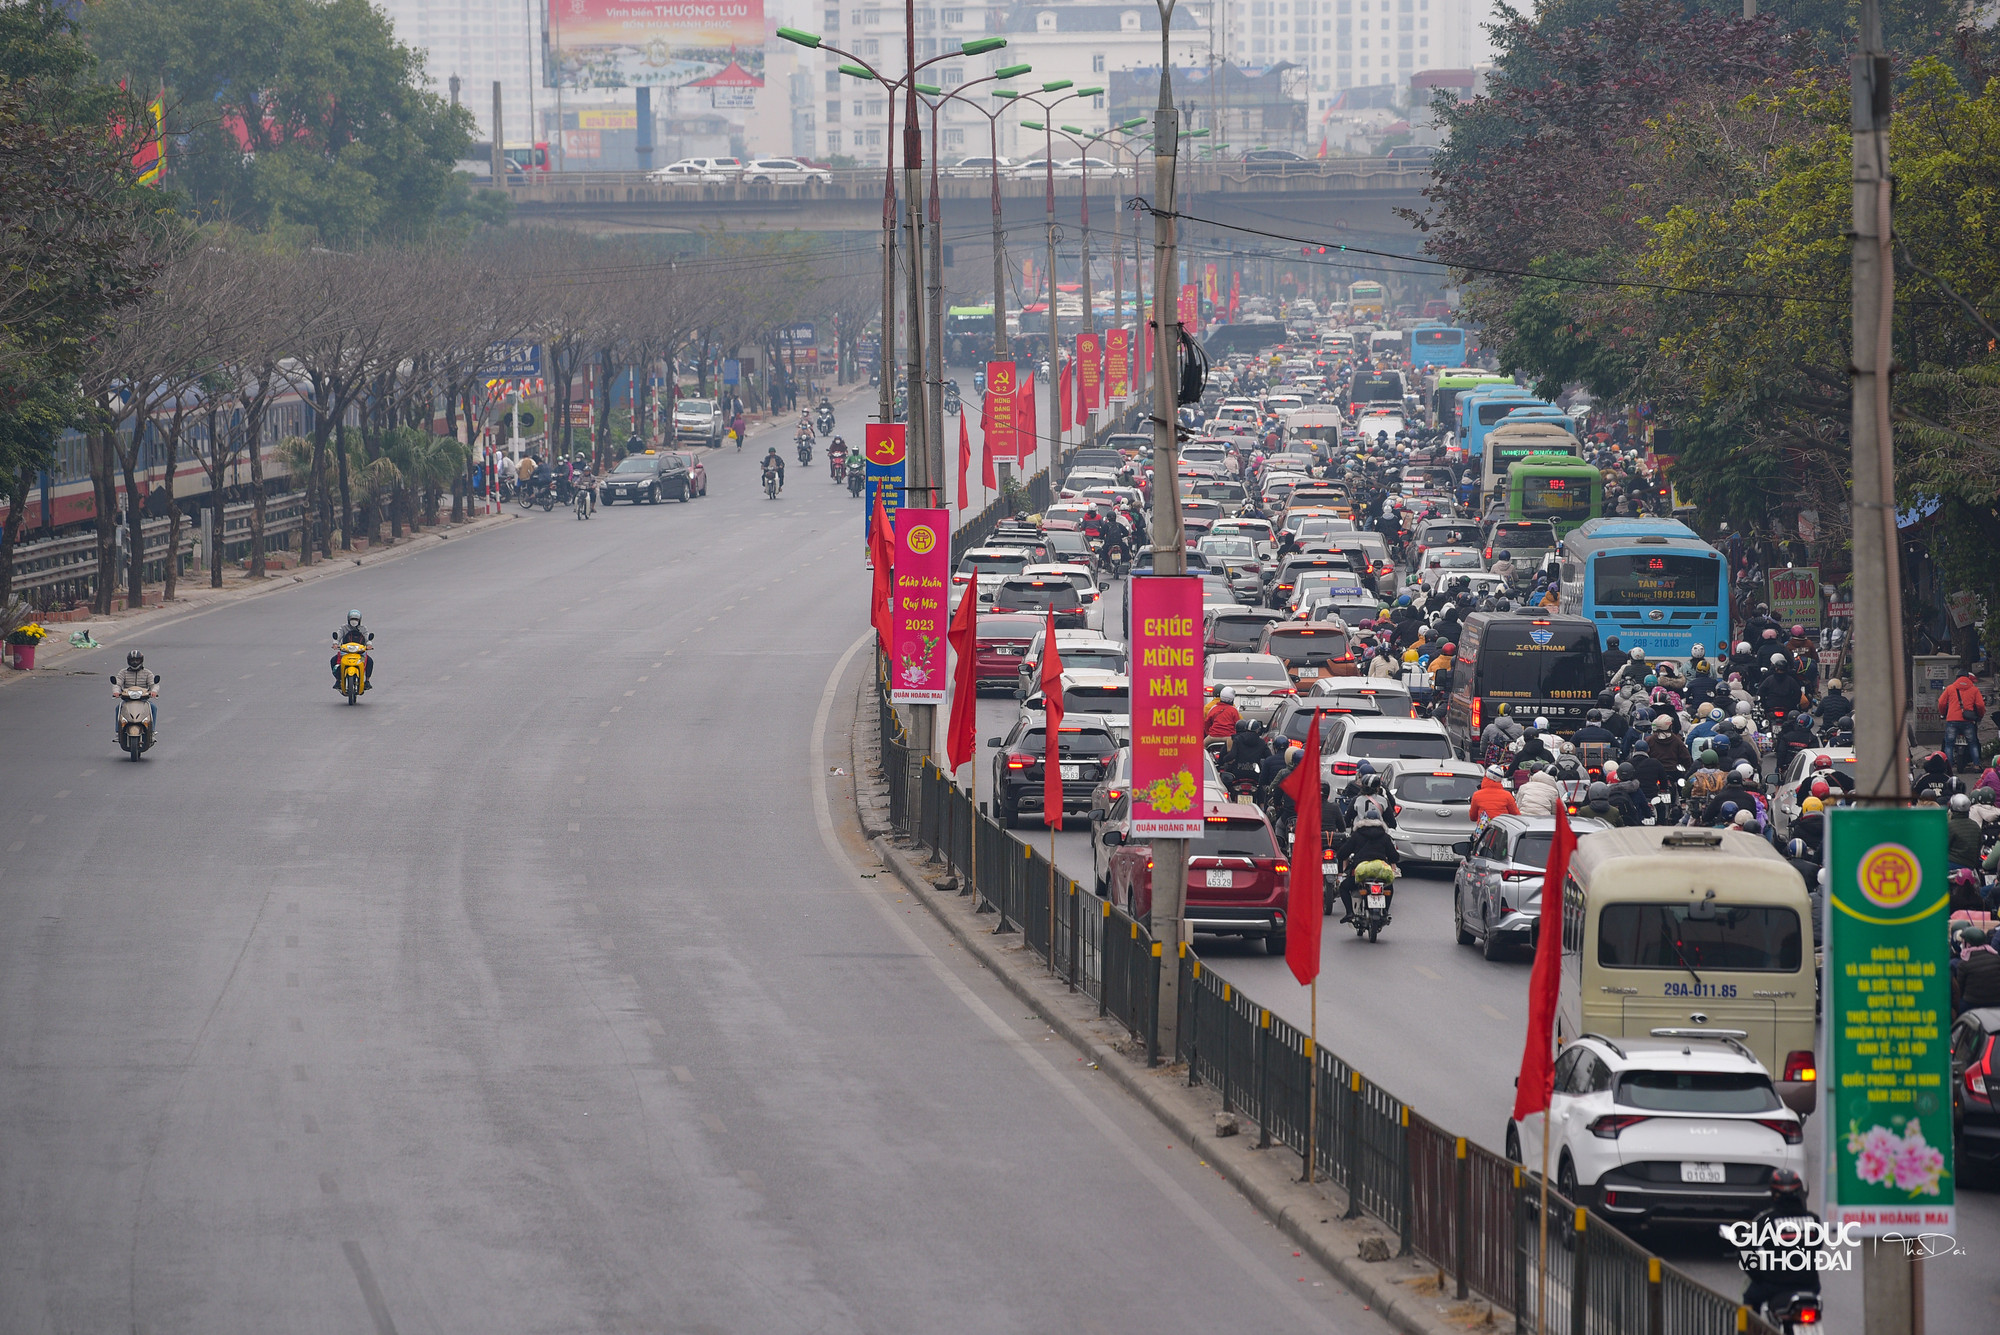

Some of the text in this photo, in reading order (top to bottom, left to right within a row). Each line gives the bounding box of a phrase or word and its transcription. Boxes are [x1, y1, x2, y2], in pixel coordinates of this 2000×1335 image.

[655, 4, 715, 19] THƯỢNG
[720, 4, 747, 16] LƯU
[1549, 480, 1566, 490] 104
[1649, 558, 1664, 569] 6A
[898, 575, 942, 588] Chào Xuân
[1773, 572, 1797, 600] PHỞ
[1653, 590, 1696, 599] 1900.1296
[902, 597, 938, 611] Quý Mão
[905, 619, 934, 631] 2023
[1144, 614, 1193, 637] CHÚC
[1633, 639, 1648, 648] 29B
[1654, 639, 1680, 648] 210.03
[1142, 644, 1194, 666] MỪNG
[1150, 674, 1188, 696] NĂM
[894, 690, 908, 700] QUẬN
[910, 690, 930, 699] HOÀNG
[1550, 690, 1592, 699] 19001731
[1152, 704, 1185, 727] MỚI
[1141, 734, 1197, 746] XUÂN QUÝ MÃO
[1159, 748, 1178, 756] 2023
[1136, 822, 1201, 833] QUẬN HOÀNG MAI
[1212, 870, 1226, 878] 30F
[1208, 878, 1232, 886] 453.29
[1871, 944, 1910, 962] ĐẢNG BỘ
[1846, 960, 1936, 976] VÀ NHÂN DÂN THỦ ĐÔ
[1664, 982, 1738, 998] 29A-011.85
[1753, 990, 1796, 998] COUNTY
[1858, 978, 1924, 993] RA SỨC THI ĐUA
[1867, 992, 1916, 1008] QUYẾT TÂM
[1846, 1008, 1936, 1025] THỰC HIỆN THẮNG LỢI
[1845, 1025, 1874, 1041] NHIỆM
[1876, 1027, 1888, 1041] VỤ
[1888, 1024, 1911, 1040] PHÁT
[1856, 1040, 1879, 1054] KINH
[1880, 1040, 1890, 1055] TẾ
[1898, 1041, 1910, 1055] XÃ
[1911, 1040, 1927, 1056] HỘI
[1872, 1054, 1912, 1070] ĐẢM BẢO
[1842, 1070, 1866, 1088] QUỐC
[1866, 1071, 1896, 1086] PHÒNG
[1904, 1074, 1917, 1086] AN
[1918, 1074, 1940, 1086] NINH
[1868, 1089, 1888, 1102] NĂM
[1890, 1090, 1912, 1102] 2023
[1687, 1170, 1720, 1180] 010.90
[1843, 1210, 1948, 1227] QUẬN HOÀNG MAI
